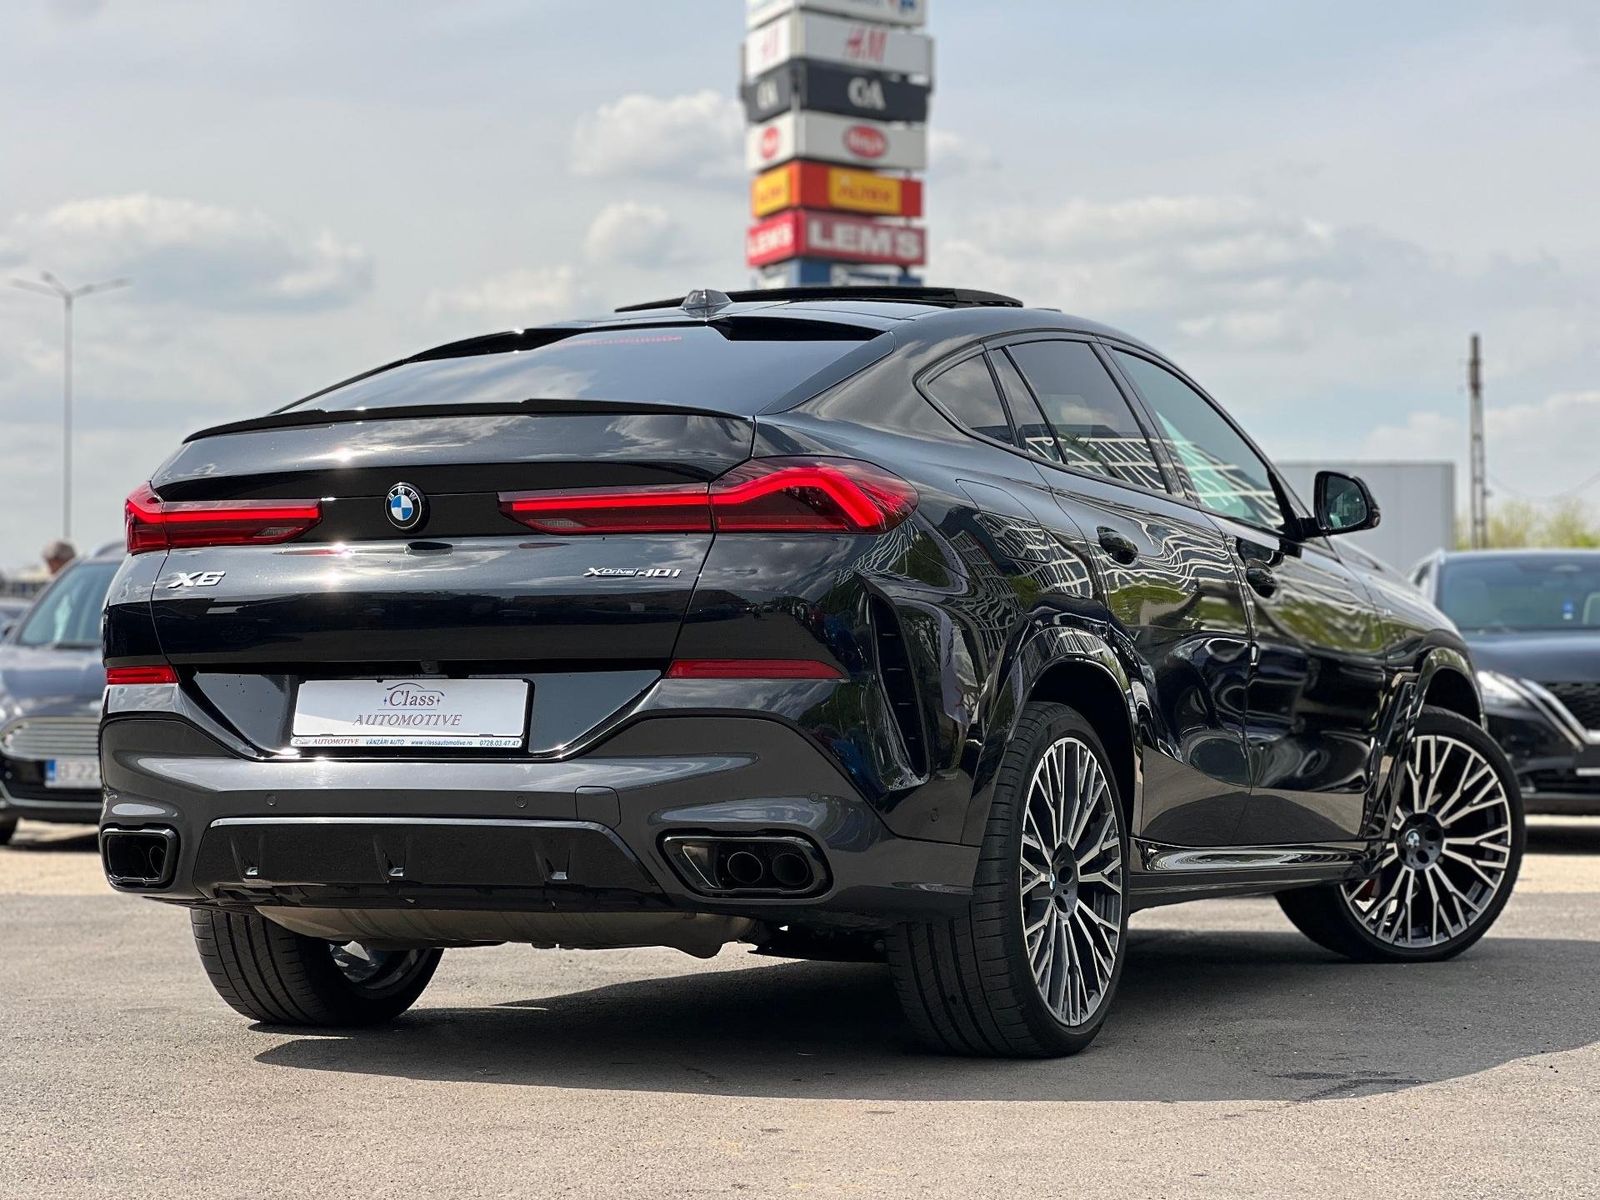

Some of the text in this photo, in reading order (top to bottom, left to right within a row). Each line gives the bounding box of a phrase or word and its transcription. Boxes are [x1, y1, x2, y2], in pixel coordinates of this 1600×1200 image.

[167, 571, 226, 588] X6
[389, 690, 435, 707] Class
[353, 713, 462, 726] AUTOMOTIVE
[313, 737, 360, 745] AUTOMOTIVE
[389, 738, 405, 746] AUTO
[411, 738, 474, 746] www.classautomotive.ro
[479, 739, 520, 747] 0728.03.47.47
